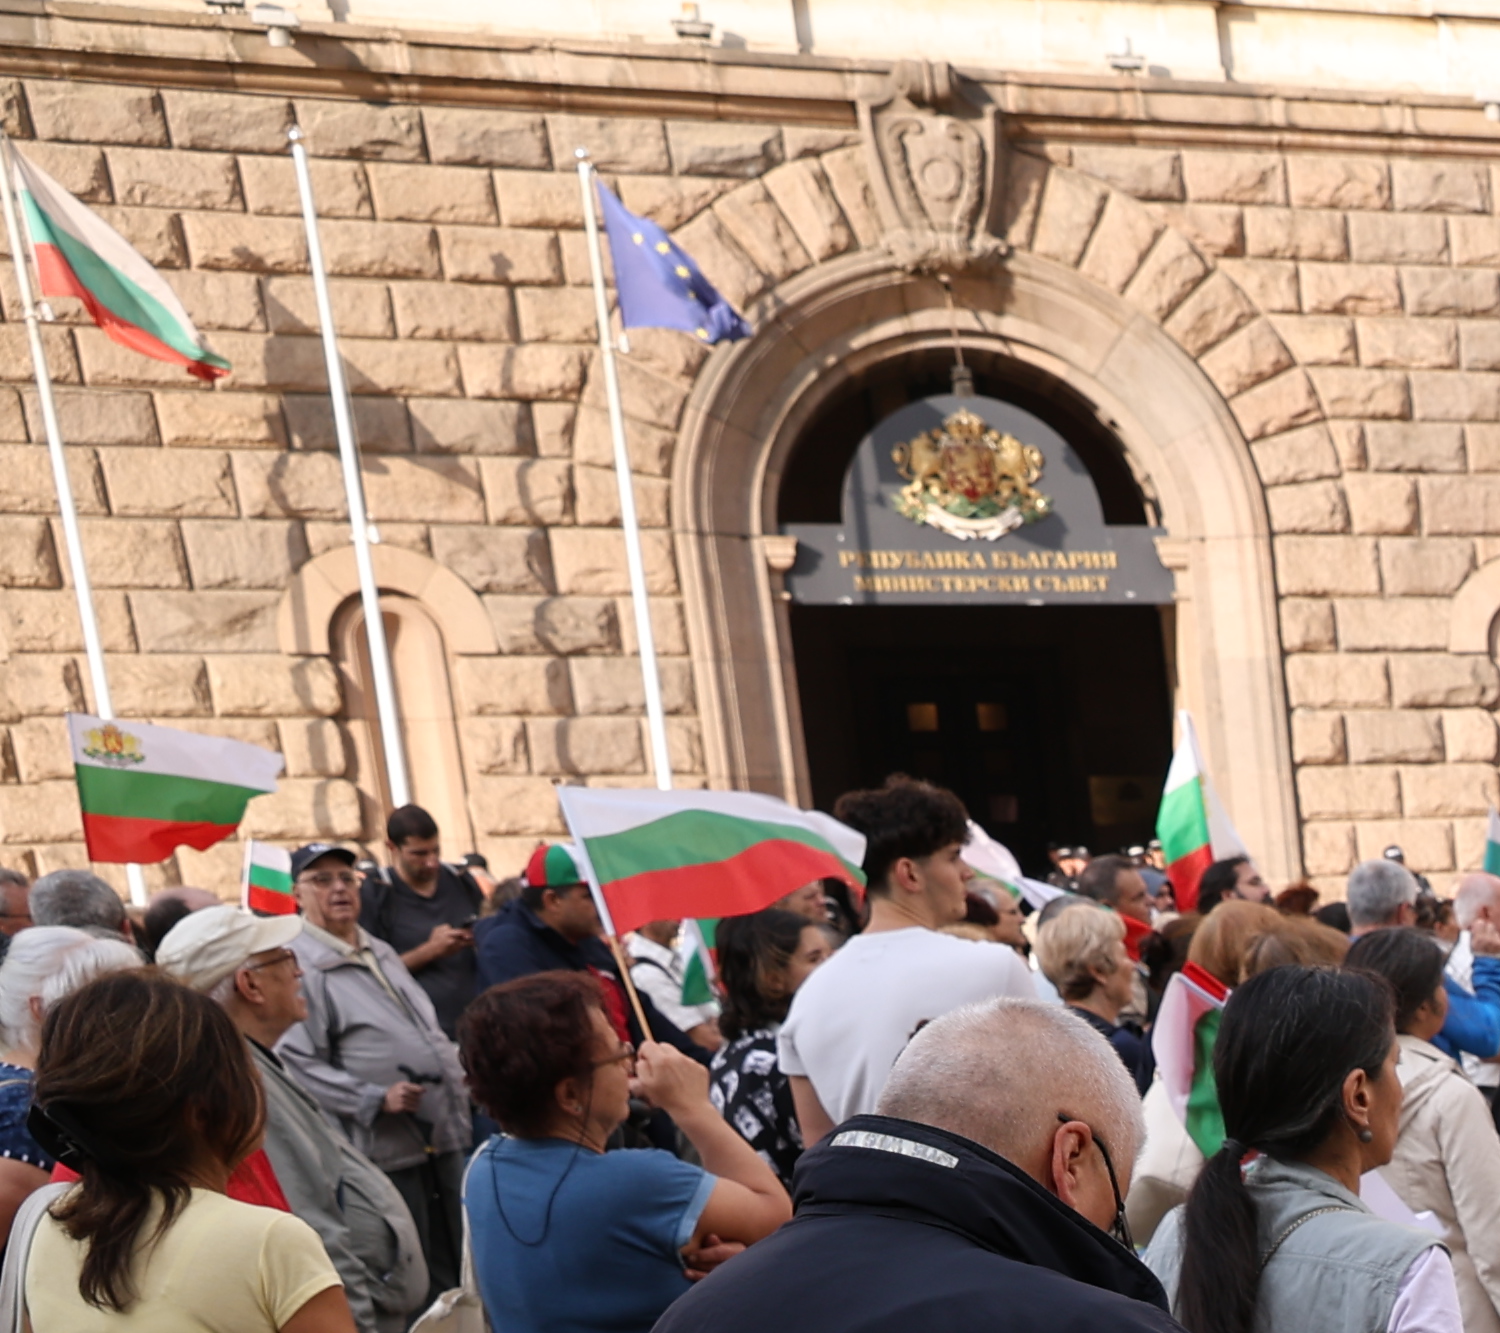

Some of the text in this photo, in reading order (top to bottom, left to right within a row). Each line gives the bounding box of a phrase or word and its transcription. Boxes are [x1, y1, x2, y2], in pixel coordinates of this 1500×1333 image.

[839, 551, 1117, 570] РЕПУБЛИКА БЪЛГАРИЯ
[855, 574, 1109, 593] МИНИСТЕРСКИ СЪВЕТ
